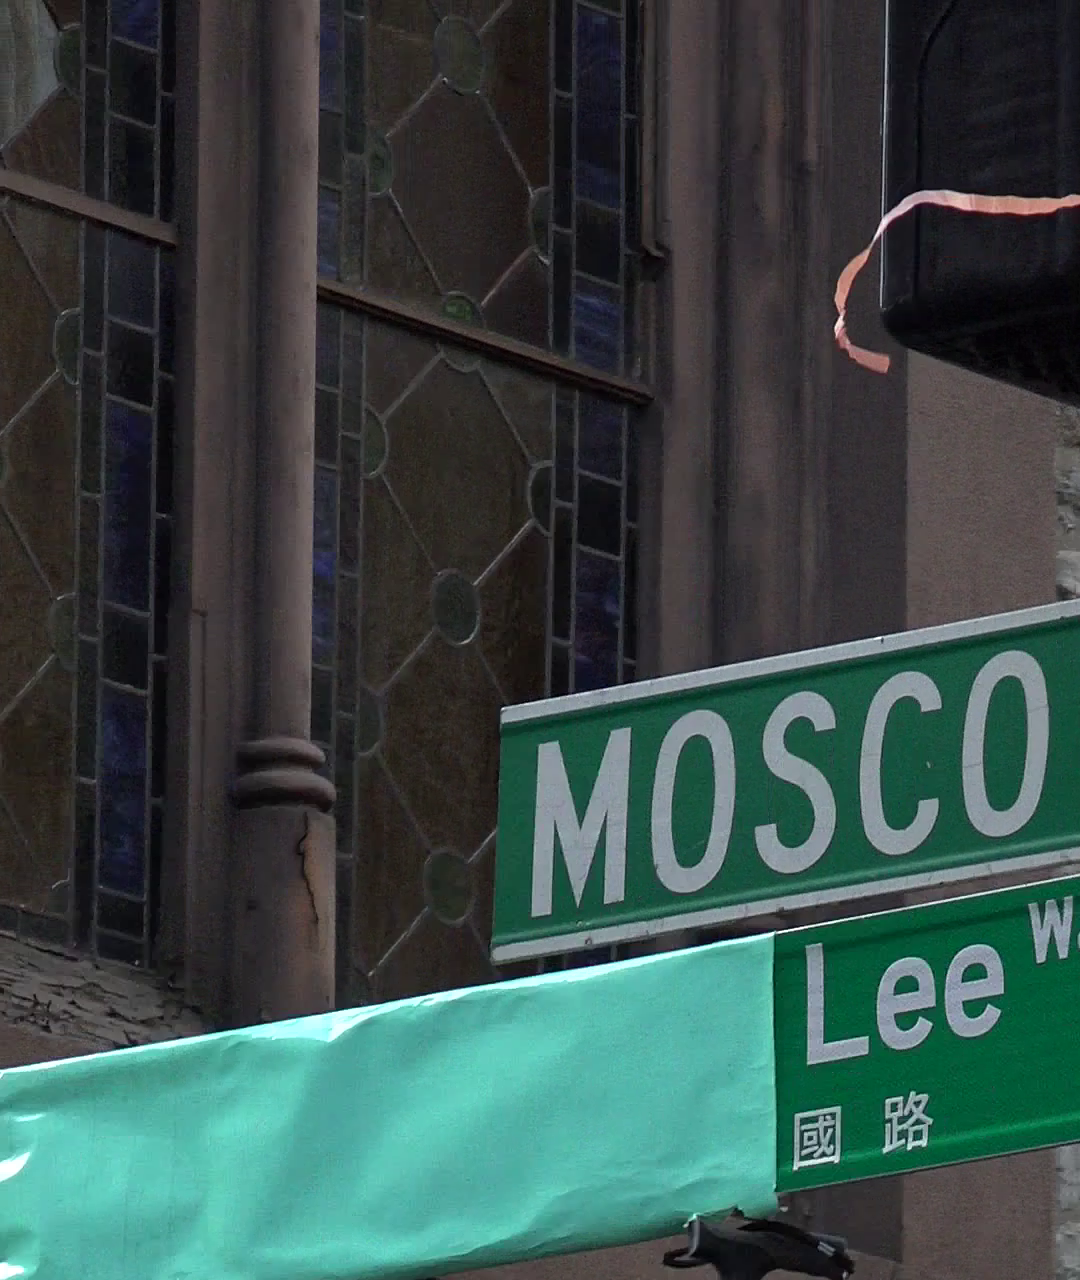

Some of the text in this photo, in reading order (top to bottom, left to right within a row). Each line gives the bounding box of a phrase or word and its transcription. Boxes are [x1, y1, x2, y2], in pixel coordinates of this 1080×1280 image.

[530, 649, 1050, 918] MOSCO
[805, 943, 1005, 1066] Lee
[792, 1090, 934, 1171] 國路
